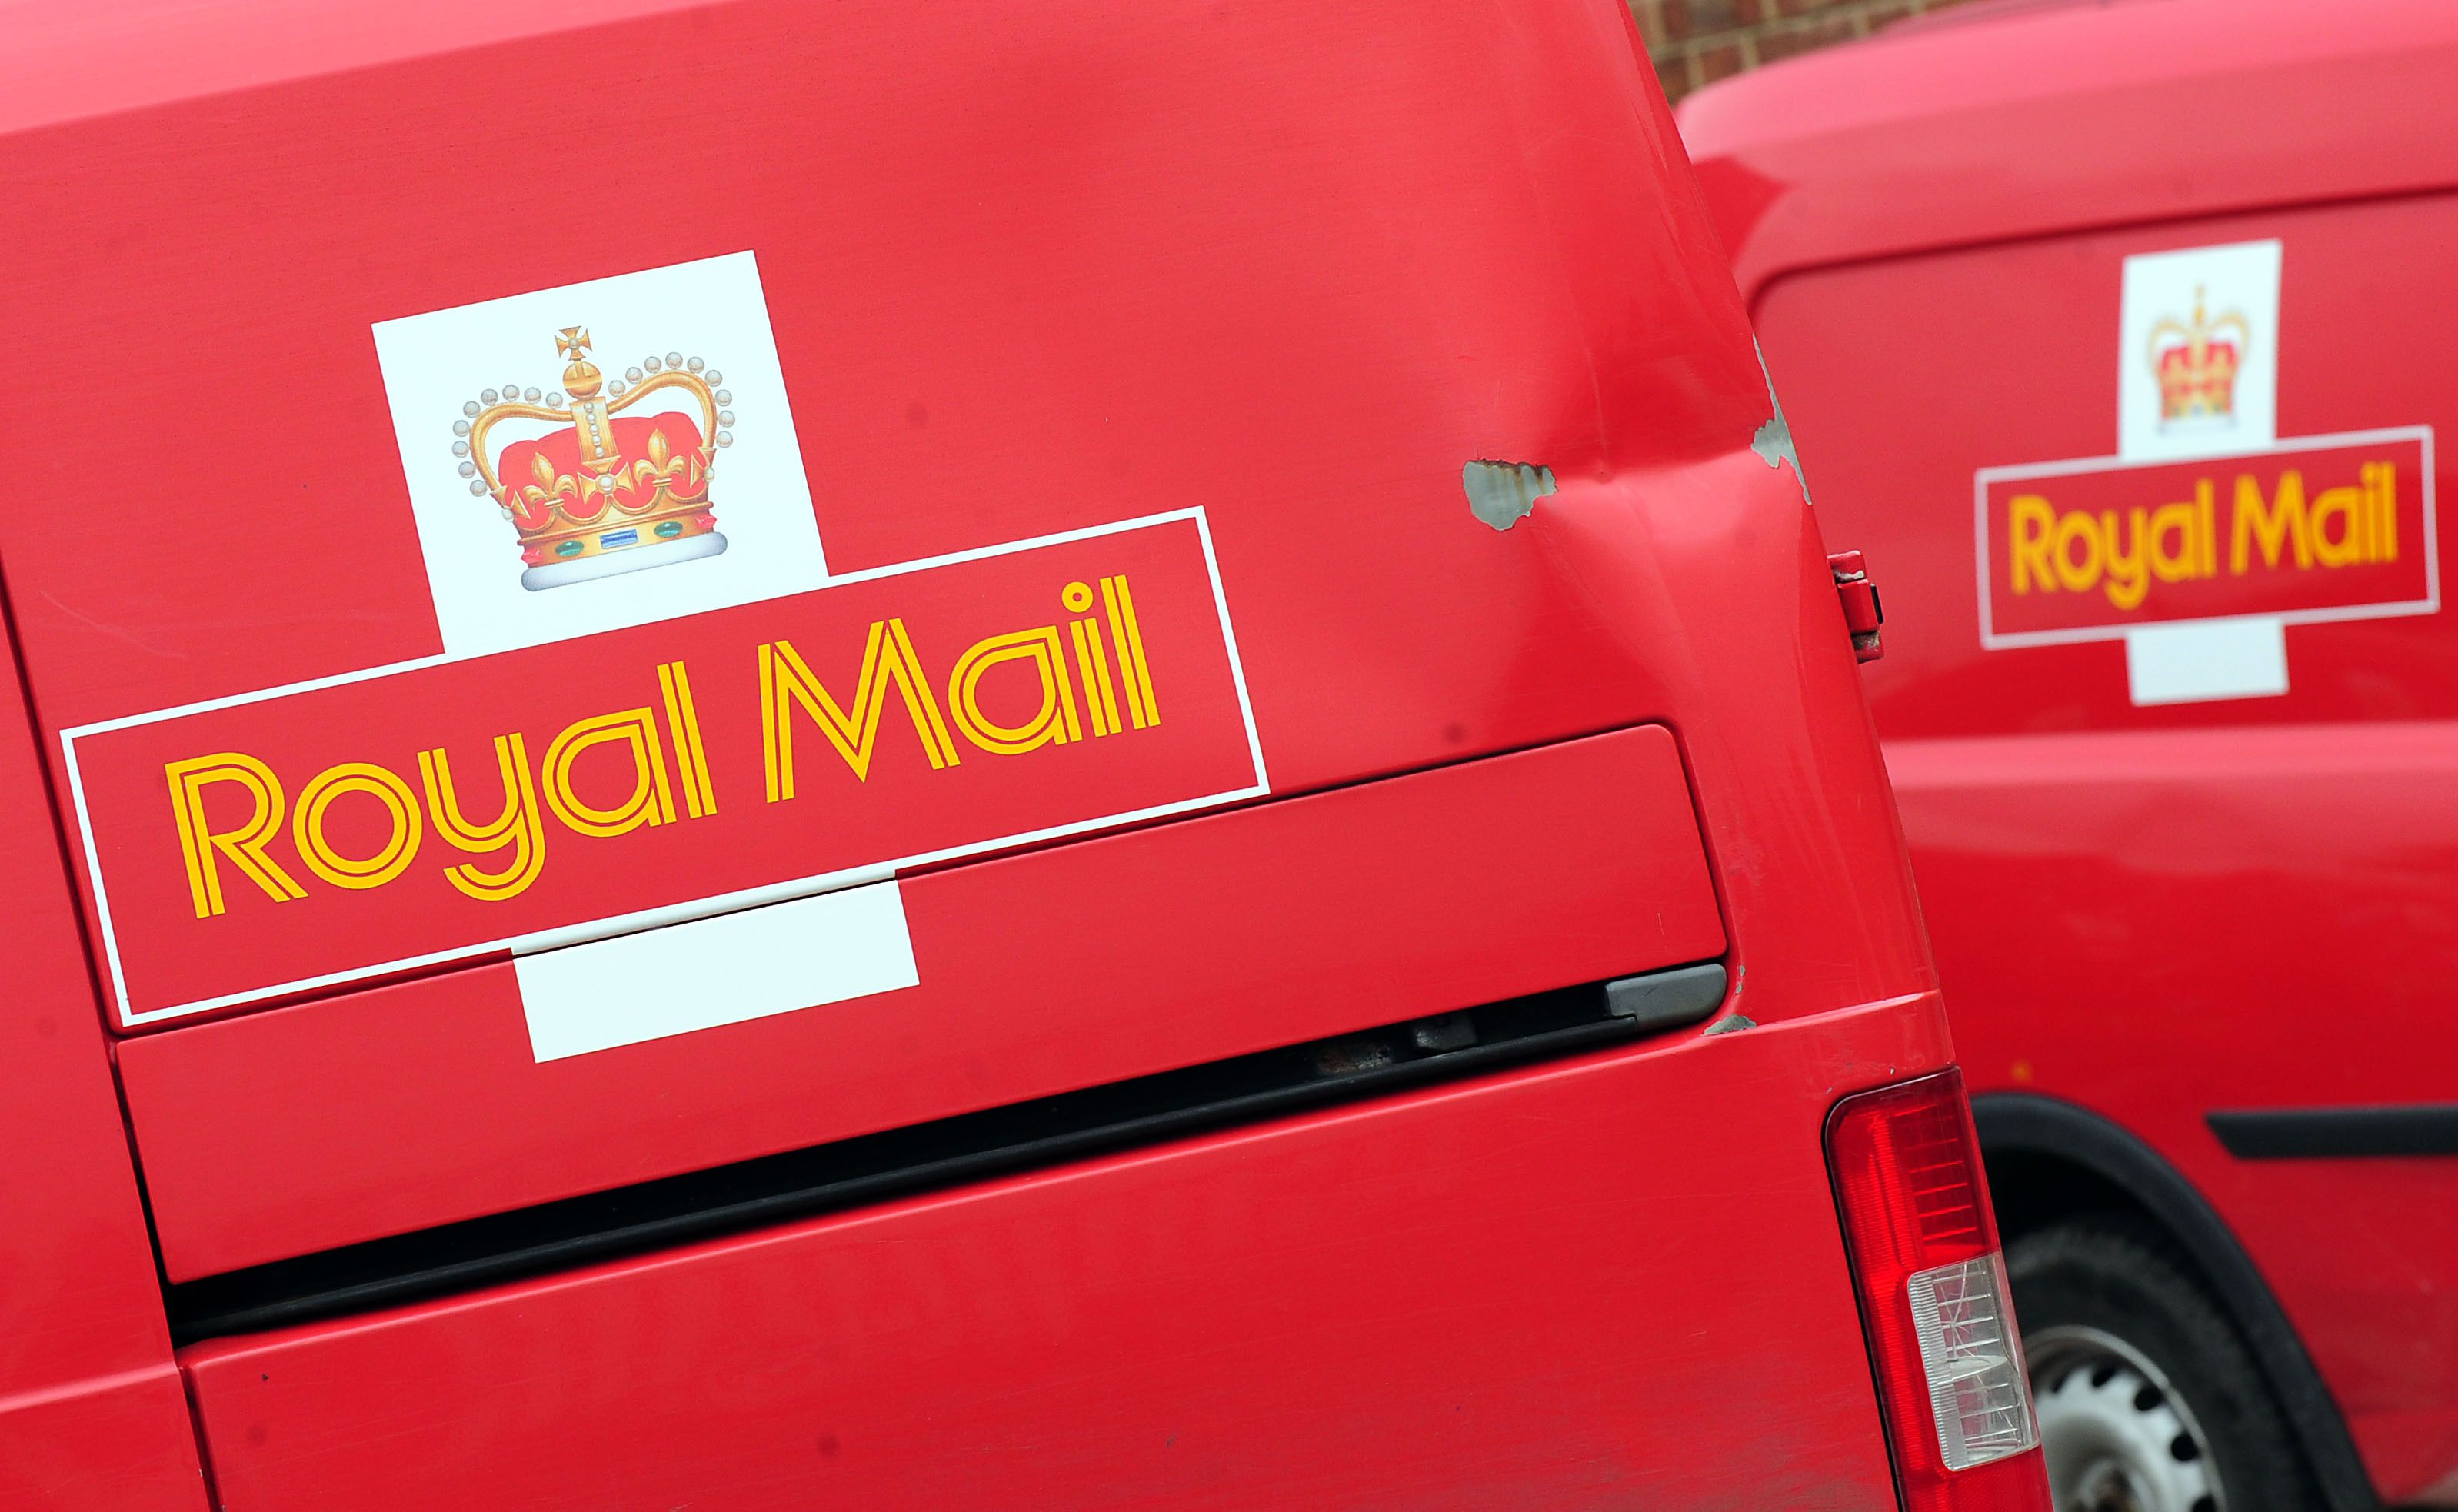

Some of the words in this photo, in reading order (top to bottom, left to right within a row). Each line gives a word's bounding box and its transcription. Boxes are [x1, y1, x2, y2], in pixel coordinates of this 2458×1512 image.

[2009, 478, 2217, 610] Royal
[2230, 461, 2398, 575] Mail
[164, 661, 718, 919] Royal
[758, 574, 1161, 804] Mail
